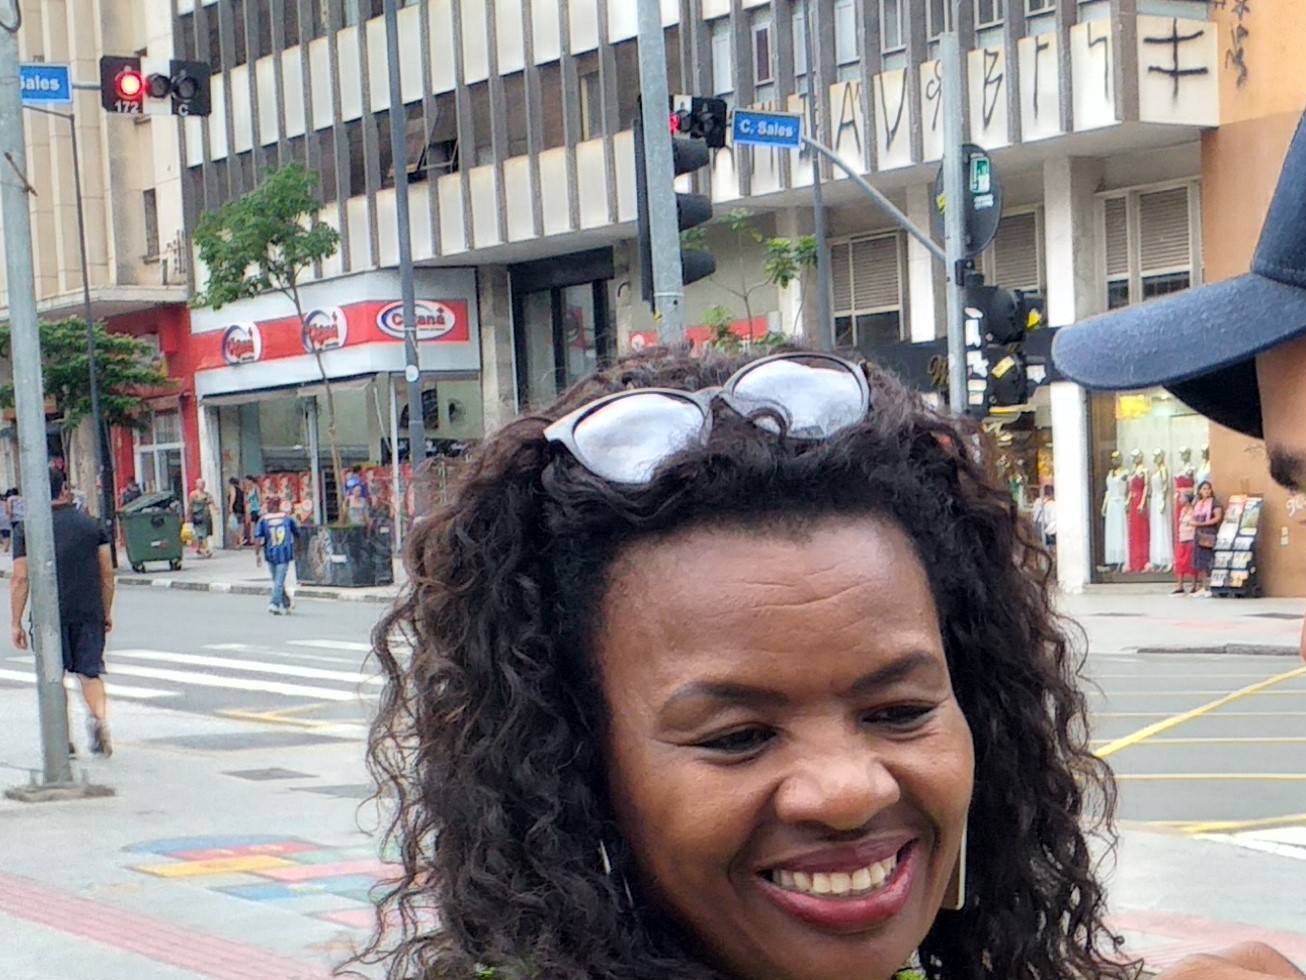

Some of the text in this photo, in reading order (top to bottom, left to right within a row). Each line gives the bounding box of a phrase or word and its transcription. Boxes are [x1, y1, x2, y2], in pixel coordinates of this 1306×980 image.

[115, 101, 139, 114] 172
[178, 104, 189, 116] C
[757, 120, 794, 137] Sales
